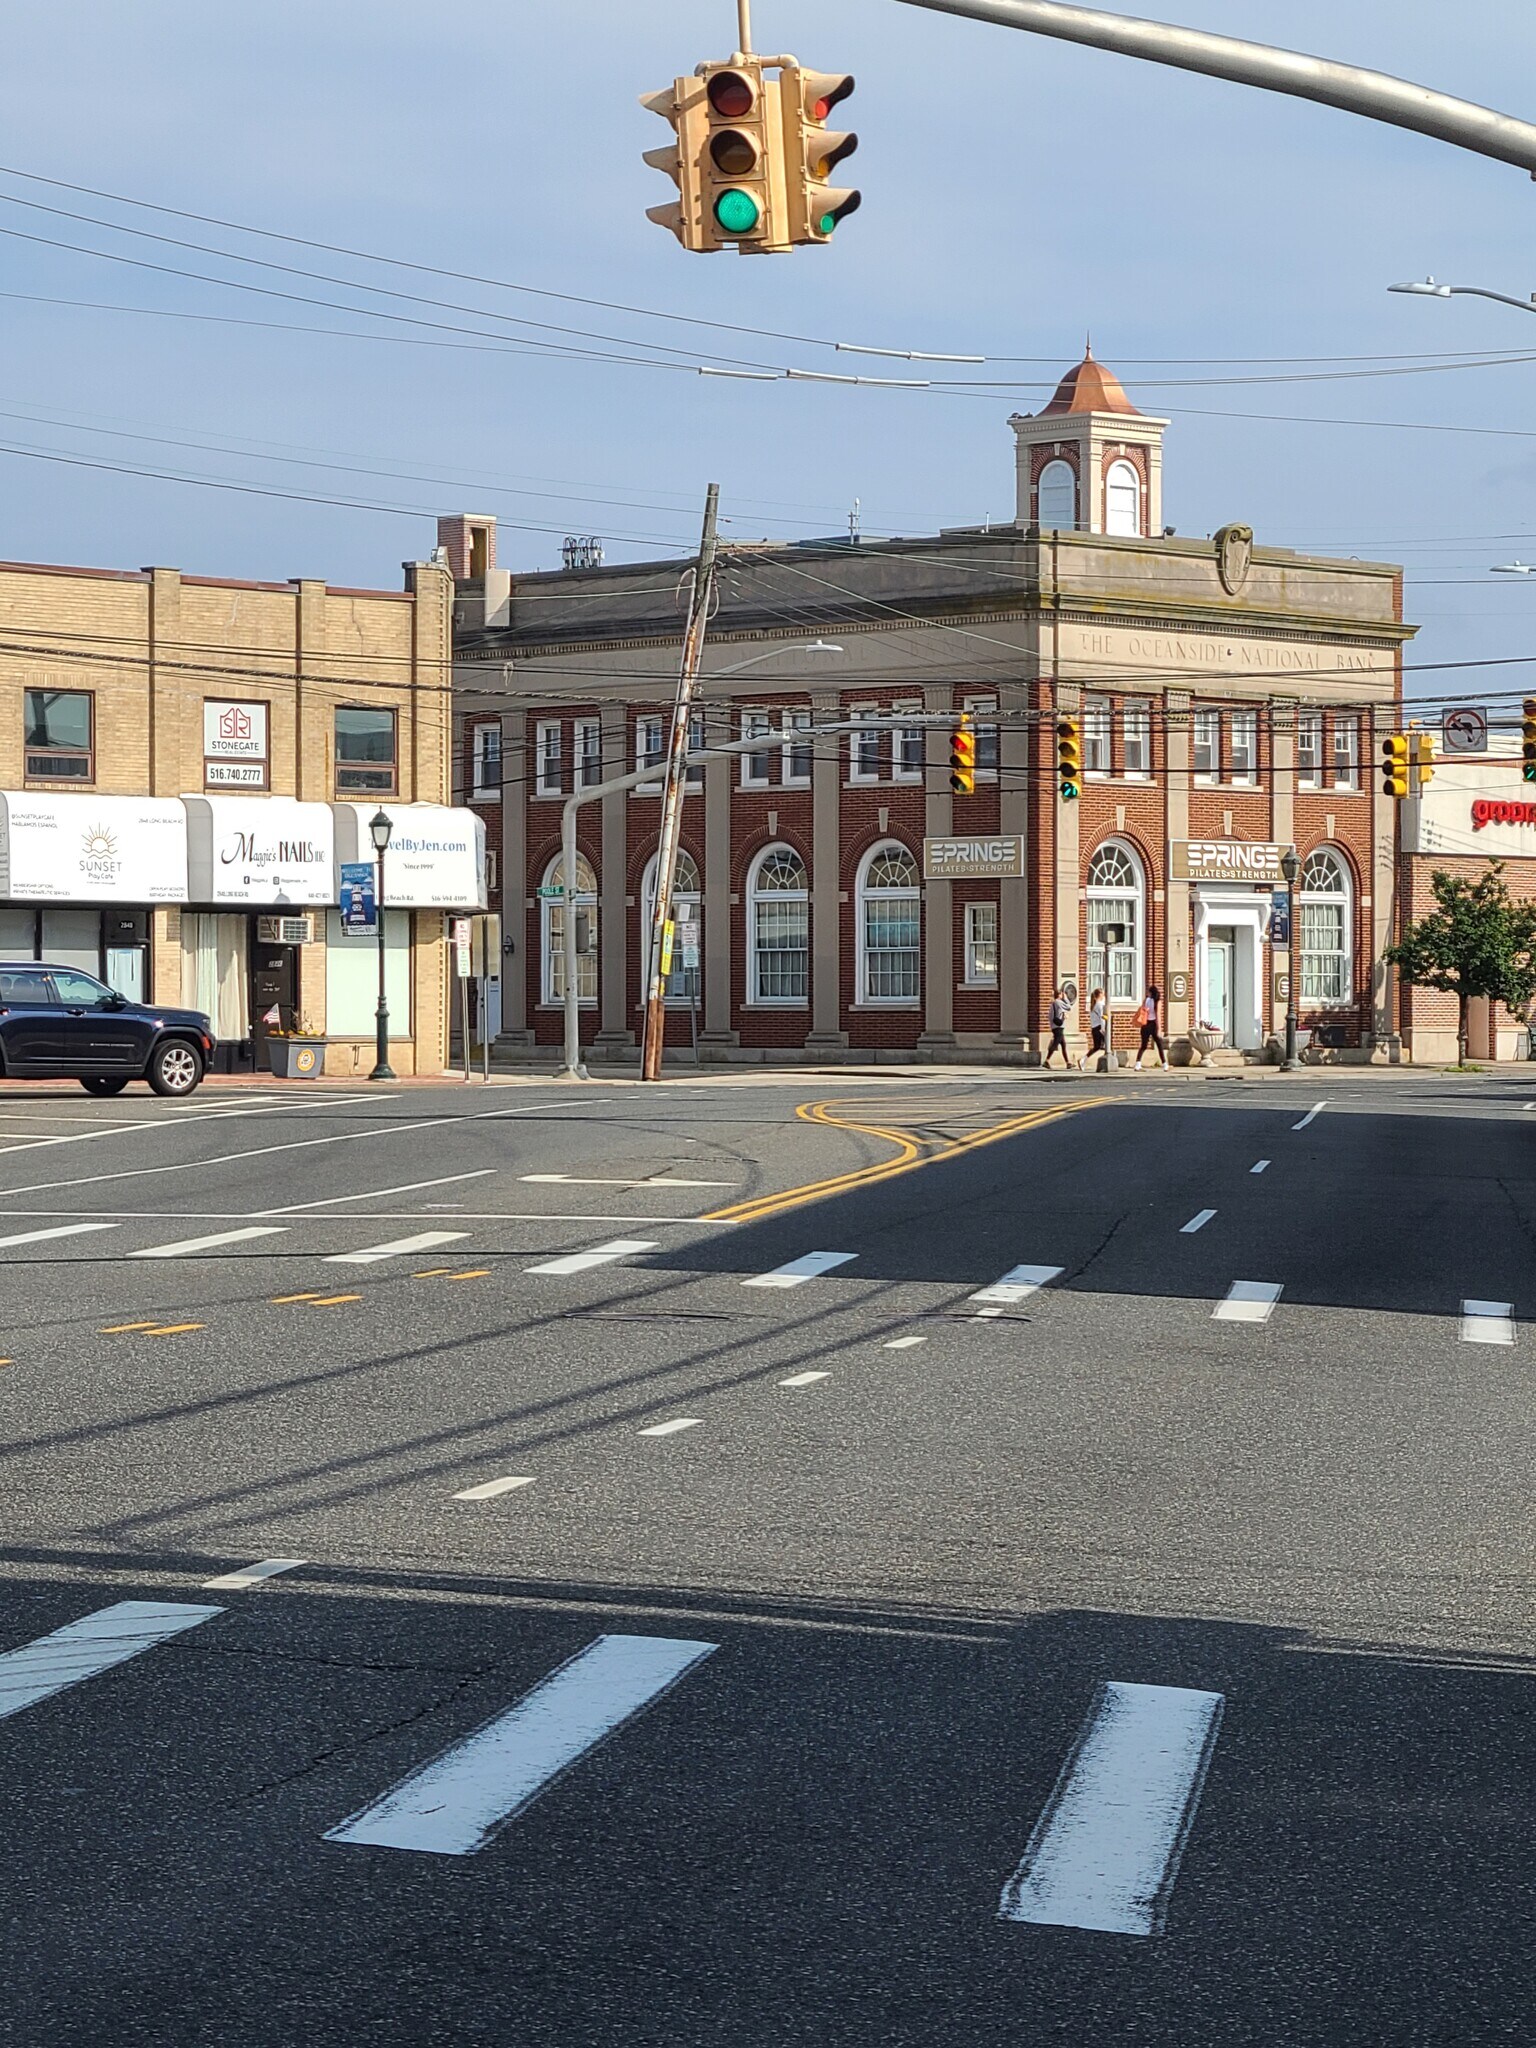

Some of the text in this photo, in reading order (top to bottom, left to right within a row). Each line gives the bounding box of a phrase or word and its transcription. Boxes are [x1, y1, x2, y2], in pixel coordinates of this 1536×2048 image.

[1079, 632, 1376, 674] THE OCEANSIDE NATIONAL BANK
[211, 740, 259, 751] STONEGATE
[210, 768, 261, 781] 516.740.2777
[221, 832, 277, 868] Maggie's
[279, 841, 314, 862] NAILS
[79, 860, 122, 872] SUNSET
[88, 872, 100, 880] Play
